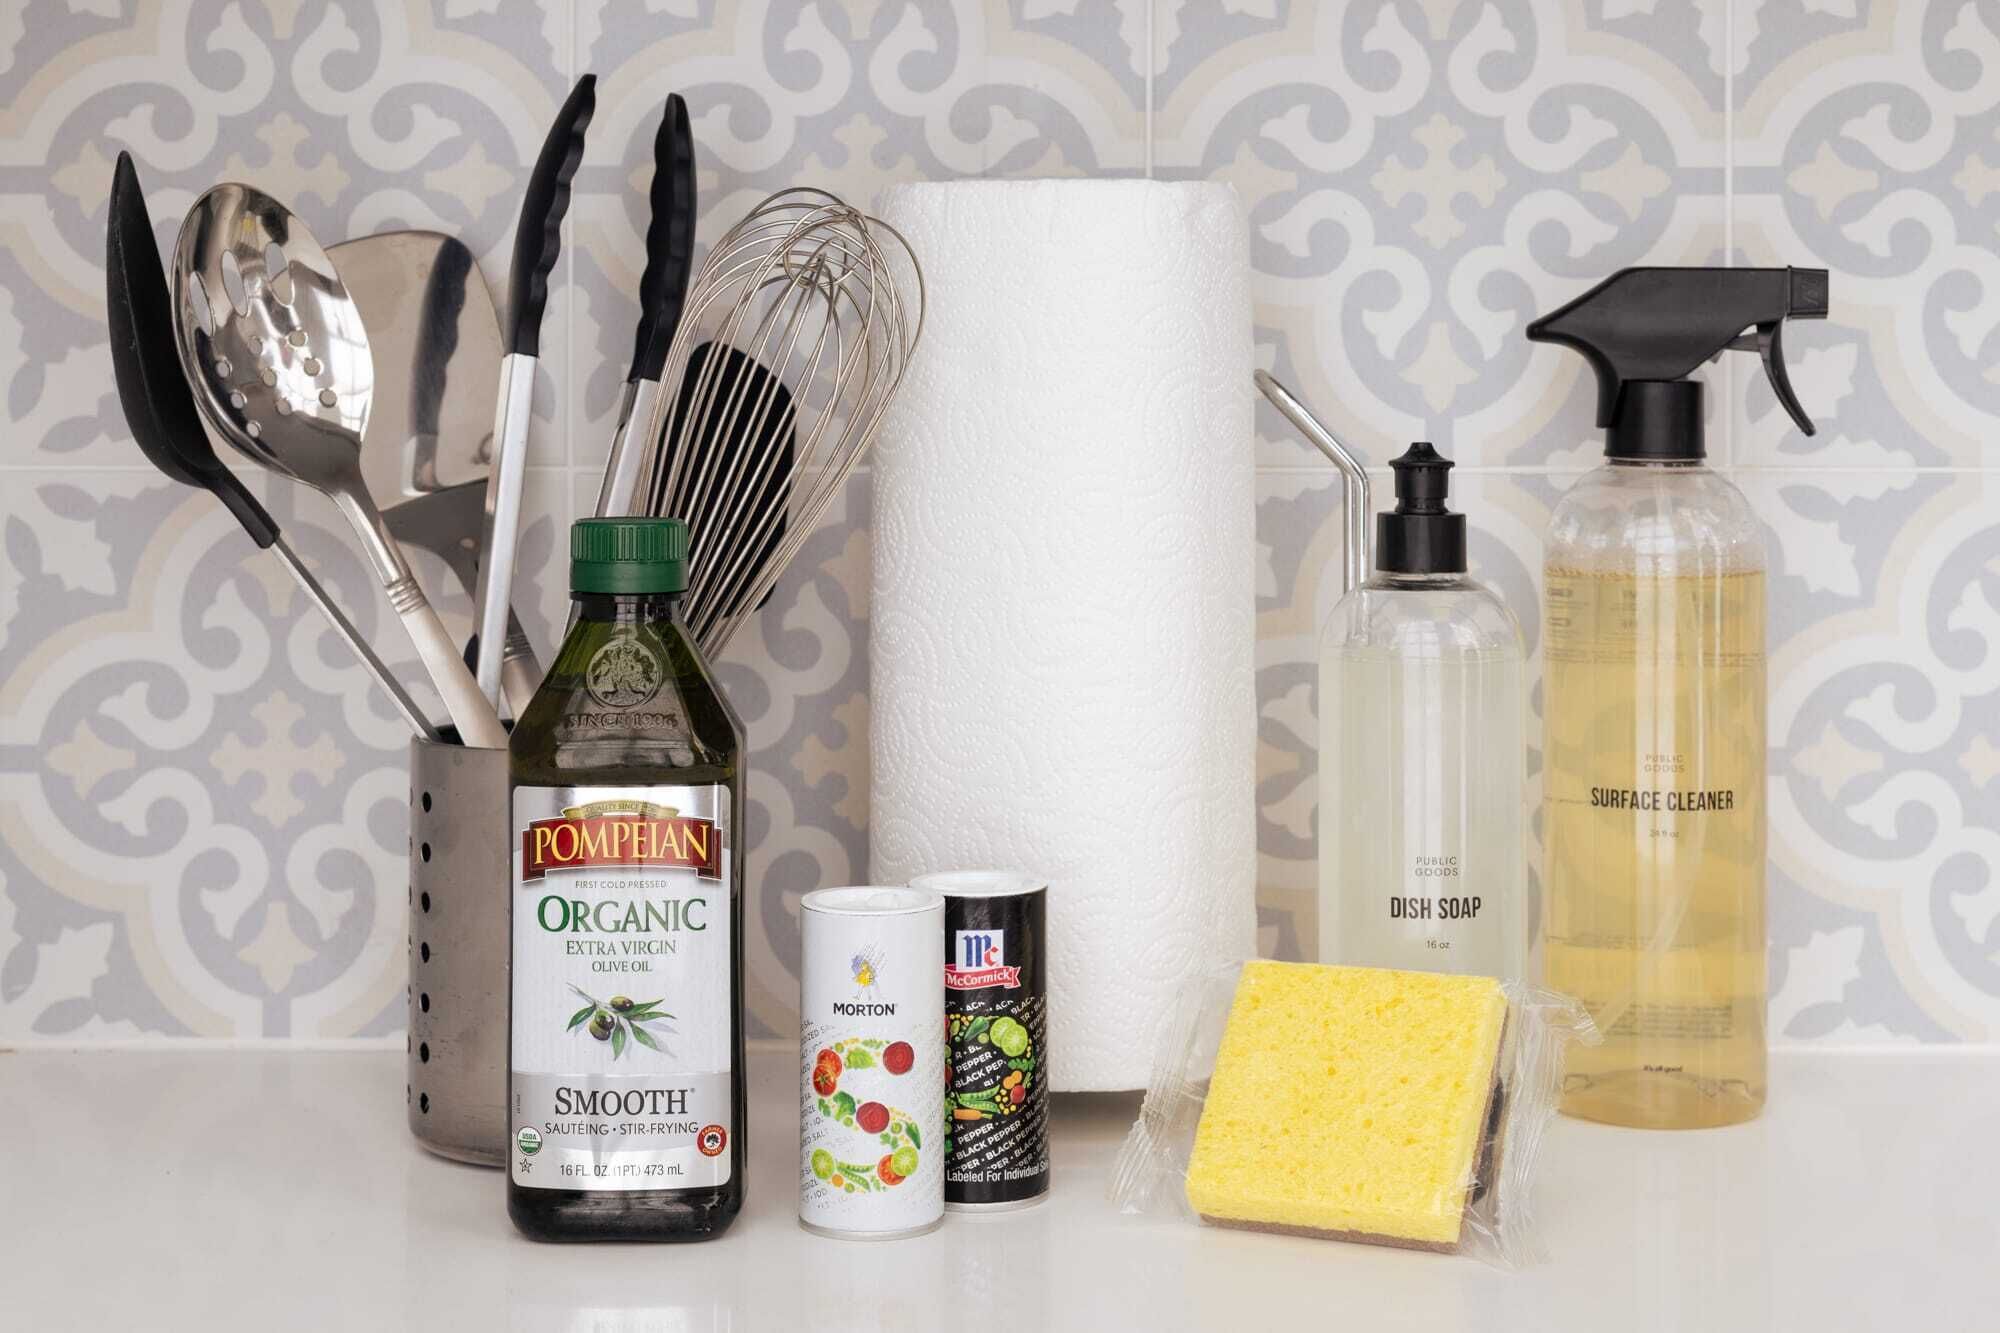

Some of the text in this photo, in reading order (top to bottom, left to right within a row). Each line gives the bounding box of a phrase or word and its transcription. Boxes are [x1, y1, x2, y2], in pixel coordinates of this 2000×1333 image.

[1591, 787, 1734, 812] SURFACE CLEANER
[533, 821, 710, 865] POMPEIAN
[1415, 856, 1458, 866] PUBLIC
[1414, 867, 1459, 877] GOODS
[575, 880, 667, 889] FIRST COLD PRESSED
[537, 895, 707, 933] ORGANIC
[1390, 896, 1482, 919] DISH SOAP
[566, 939, 677, 956] EXTRA VIRGIN
[1426, 939, 1450, 949] 16 oz
[591, 960, 653, 973] OLIVE OIL
[946, 968, 1011, 987] McCormick
[833, 1002, 896, 1017] MORTON
[955, 1051, 993, 1074] PEPPER
[955, 1069, 986, 1088] BLACK
[544, 1121, 700, 1136] SAUTÉING STIR-FRYING
[957, 1122, 995, 1145] PEPPER
[955, 1139, 989, 1160] BLACK
[987, 1120, 1021, 1145] PEPPER
[985, 1139, 1016, 1161] BLACK
[560, 1164, 573, 1176] 16
[644, 1163, 664, 1176] 473
[667, 1163, 684, 1176] mL
[946, 1169, 984, 1183] Labeled
[986, 1170, 1002, 1182] For
[1004, 1160, 1040, 1181] Individual
